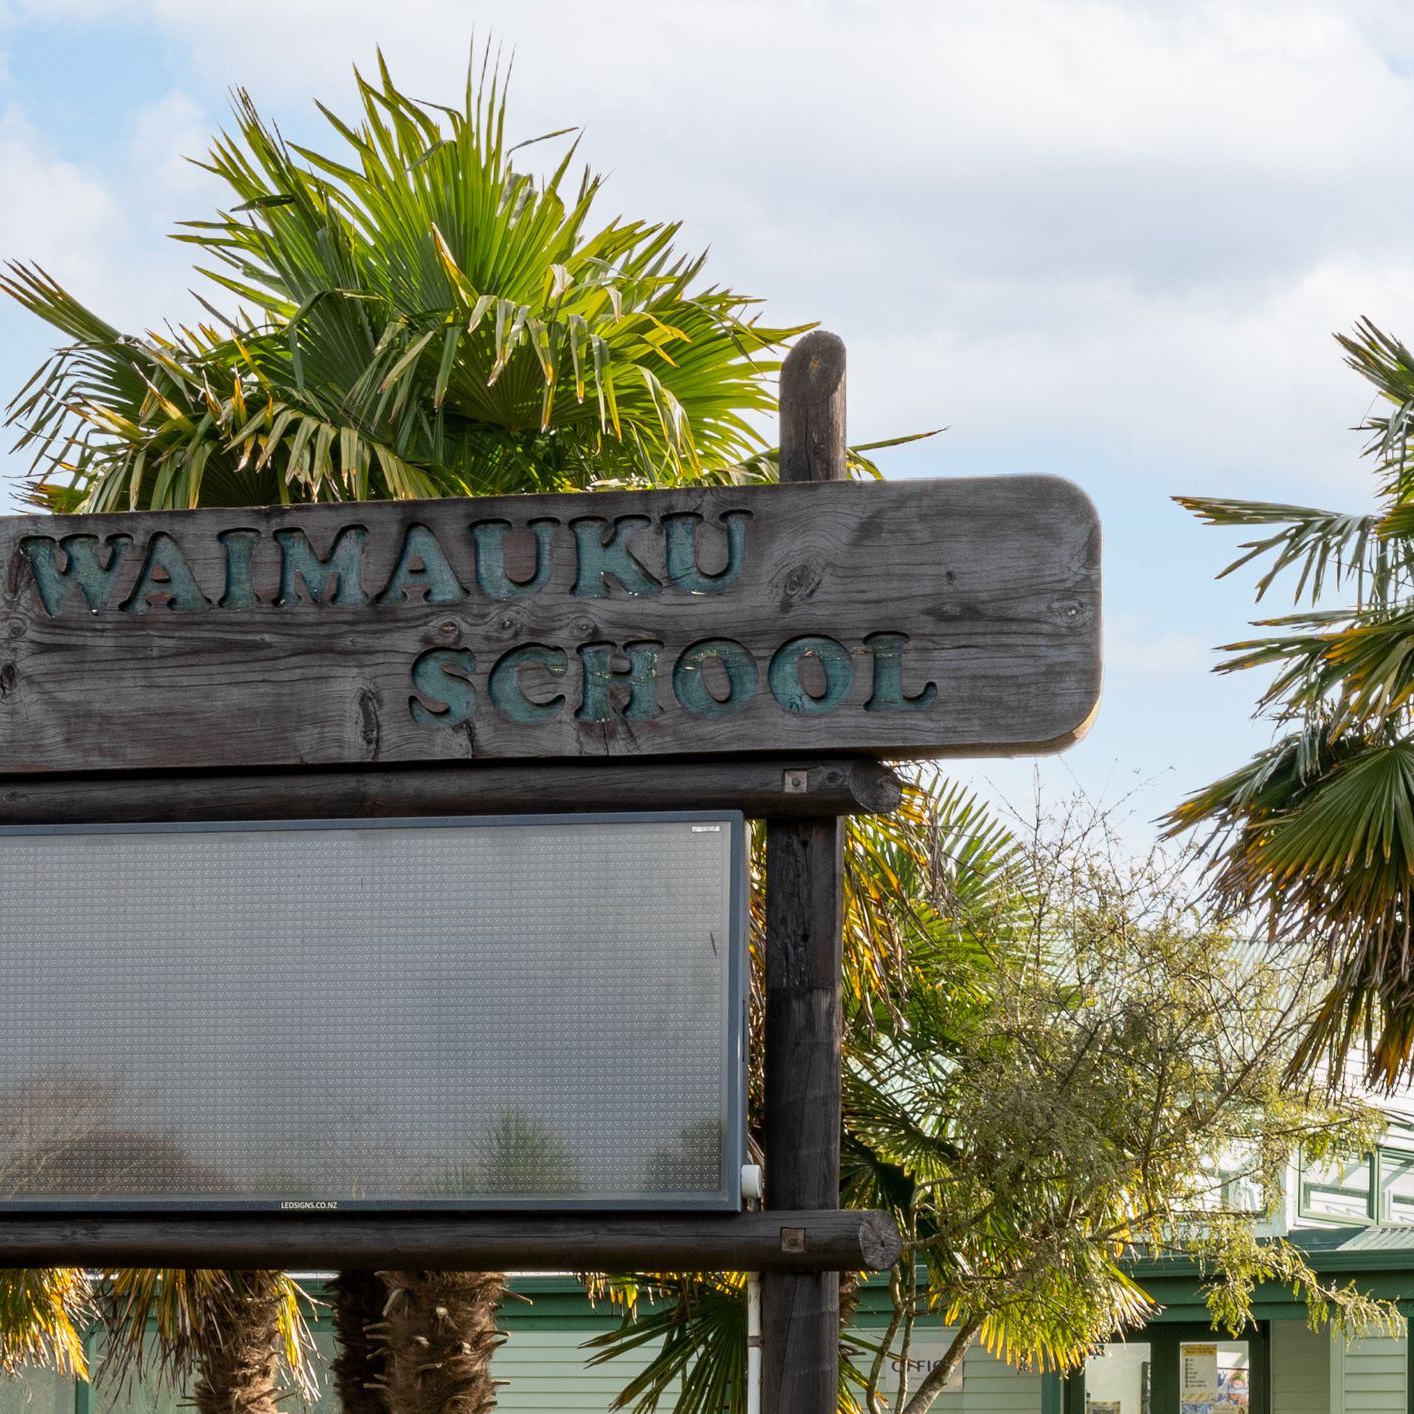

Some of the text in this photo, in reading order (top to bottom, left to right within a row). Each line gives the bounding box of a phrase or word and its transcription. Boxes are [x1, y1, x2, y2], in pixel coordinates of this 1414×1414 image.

[19, 509, 754, 617] WAIMAUKU
[408, 630, 938, 726] SCHOOL
[280, 1201, 338, 1209] LEDSIGNS.CO.NZ
